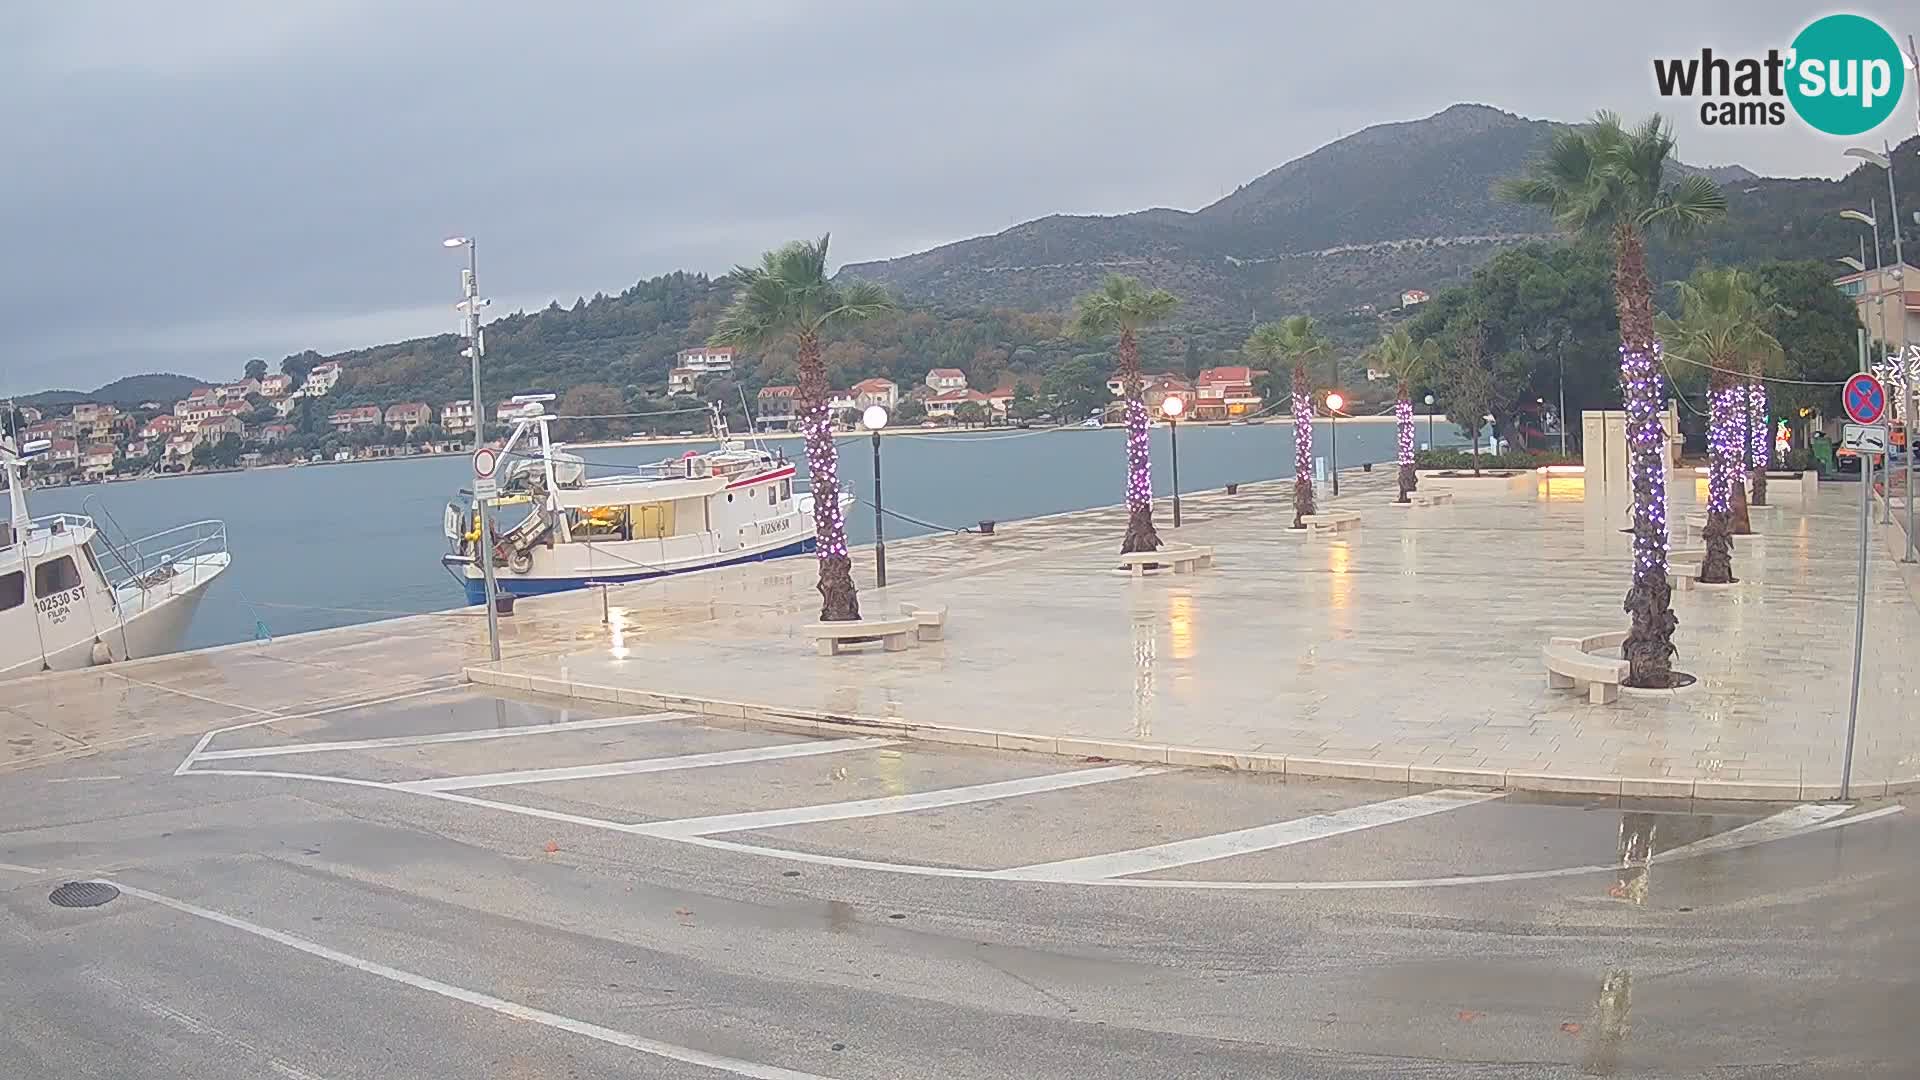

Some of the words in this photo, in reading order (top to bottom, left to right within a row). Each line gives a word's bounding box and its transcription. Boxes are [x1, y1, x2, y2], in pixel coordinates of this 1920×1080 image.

[34, 592, 70, 614] 102530
[72, 586, 85, 602] ST
[47, 606, 71, 620] FILIPA
